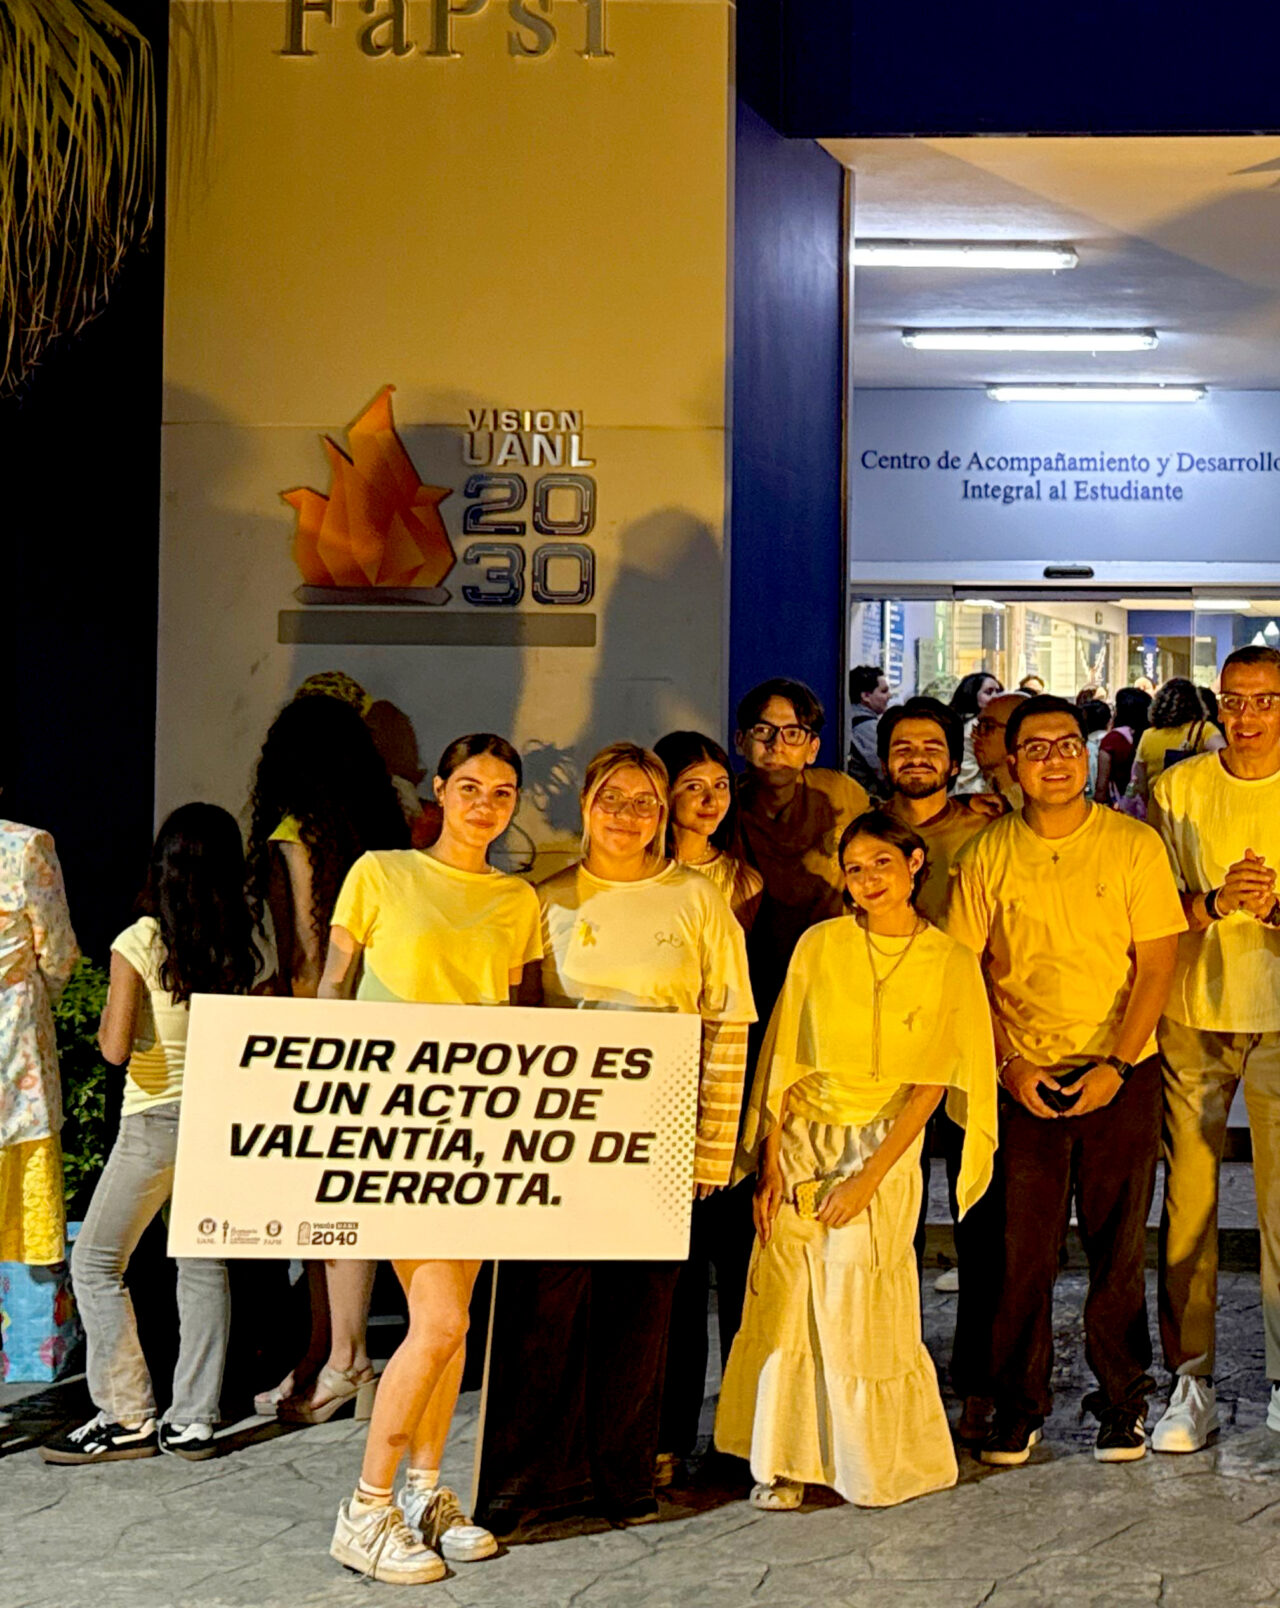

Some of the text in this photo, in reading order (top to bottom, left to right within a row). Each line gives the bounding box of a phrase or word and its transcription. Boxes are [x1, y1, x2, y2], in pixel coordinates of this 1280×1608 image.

[465, 409, 583, 433] VISION
[463, 432, 596, 467] UANL
[860, 450, 931, 471] Centro
[937, 451, 961, 471] de
[966, 451, 1150, 476] Acompañamiento
[1156, 454, 1173, 477] y
[463, 472, 597, 536] 20
[962, 480, 1183, 503] Integral al Estudiante
[461, 542, 596, 607] 30
[239, 1035, 653, 1079] PEDIR APOYO ES
[292, 1081, 603, 1120] UN ACTO DE
[229, 1117, 657, 1167] VALENTÍA, NO DE
[315, 1171, 562, 1206] DERROTA.
[311, 1231, 358, 1245] 2040
